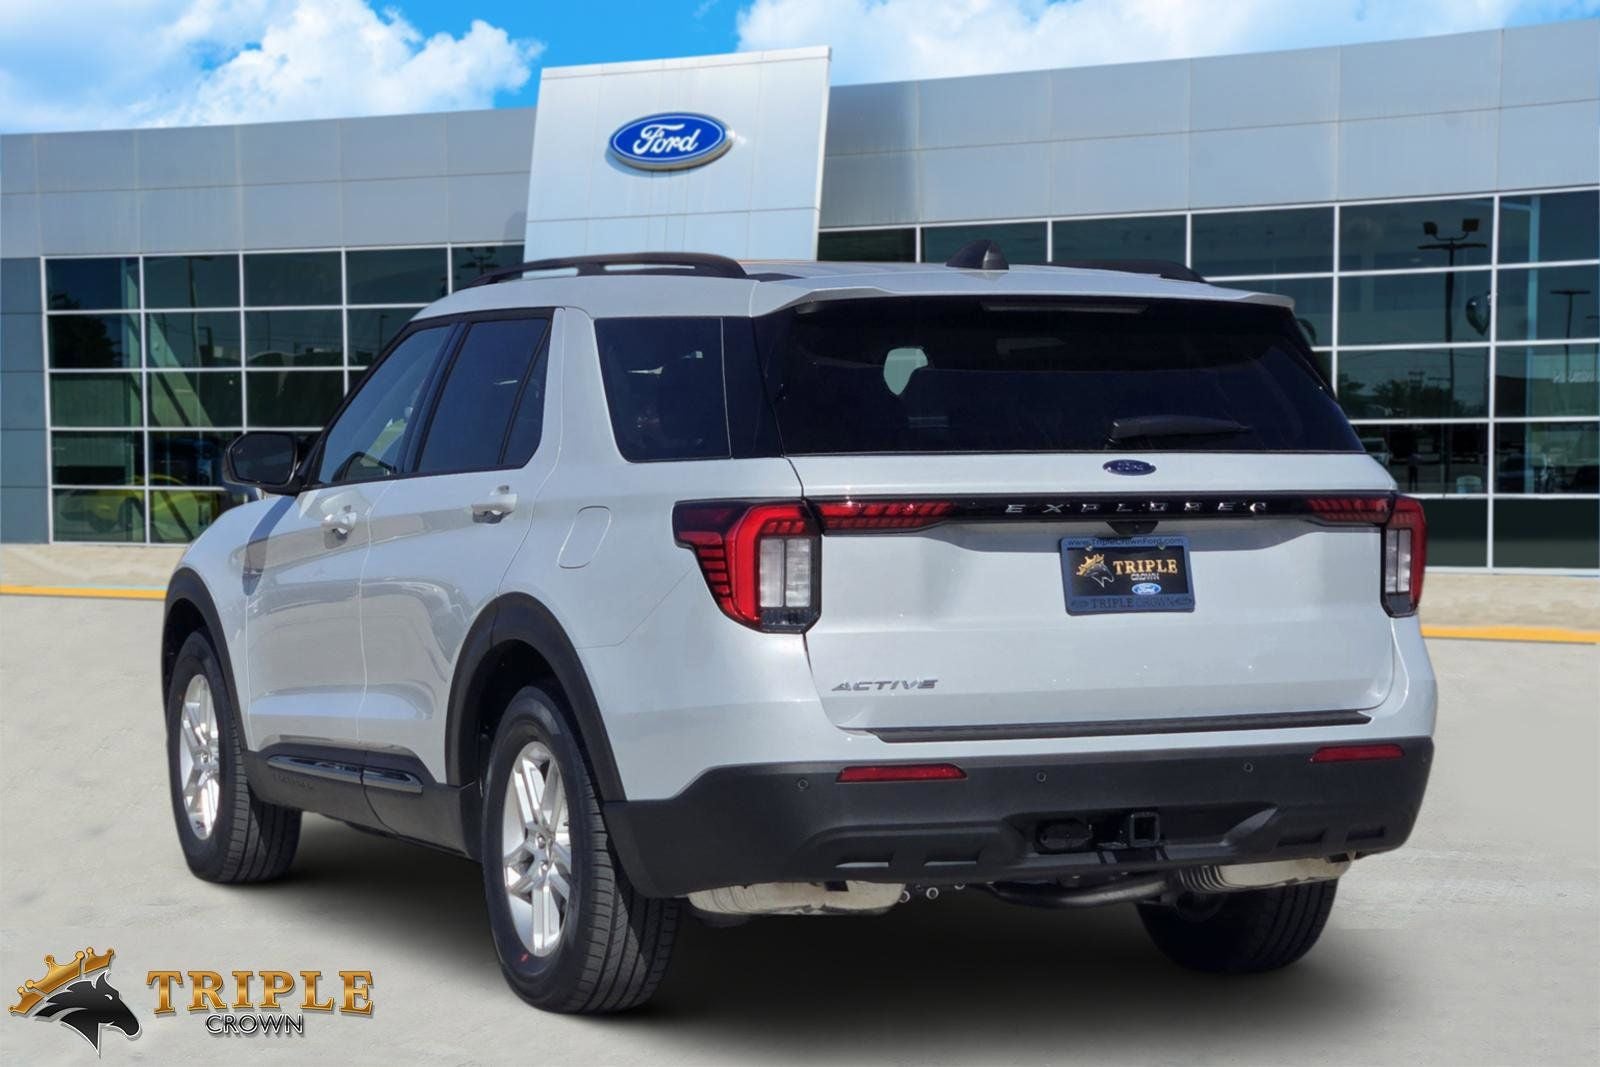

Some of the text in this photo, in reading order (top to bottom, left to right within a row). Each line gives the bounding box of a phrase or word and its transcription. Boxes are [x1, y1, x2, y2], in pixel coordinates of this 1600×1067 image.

[632, 123, 702, 155] Ford
[1005, 501, 1268, 514] EXPLORER
[1113, 559, 1178, 575] TRIPLE
[831, 679, 939, 692] ACTIVE
